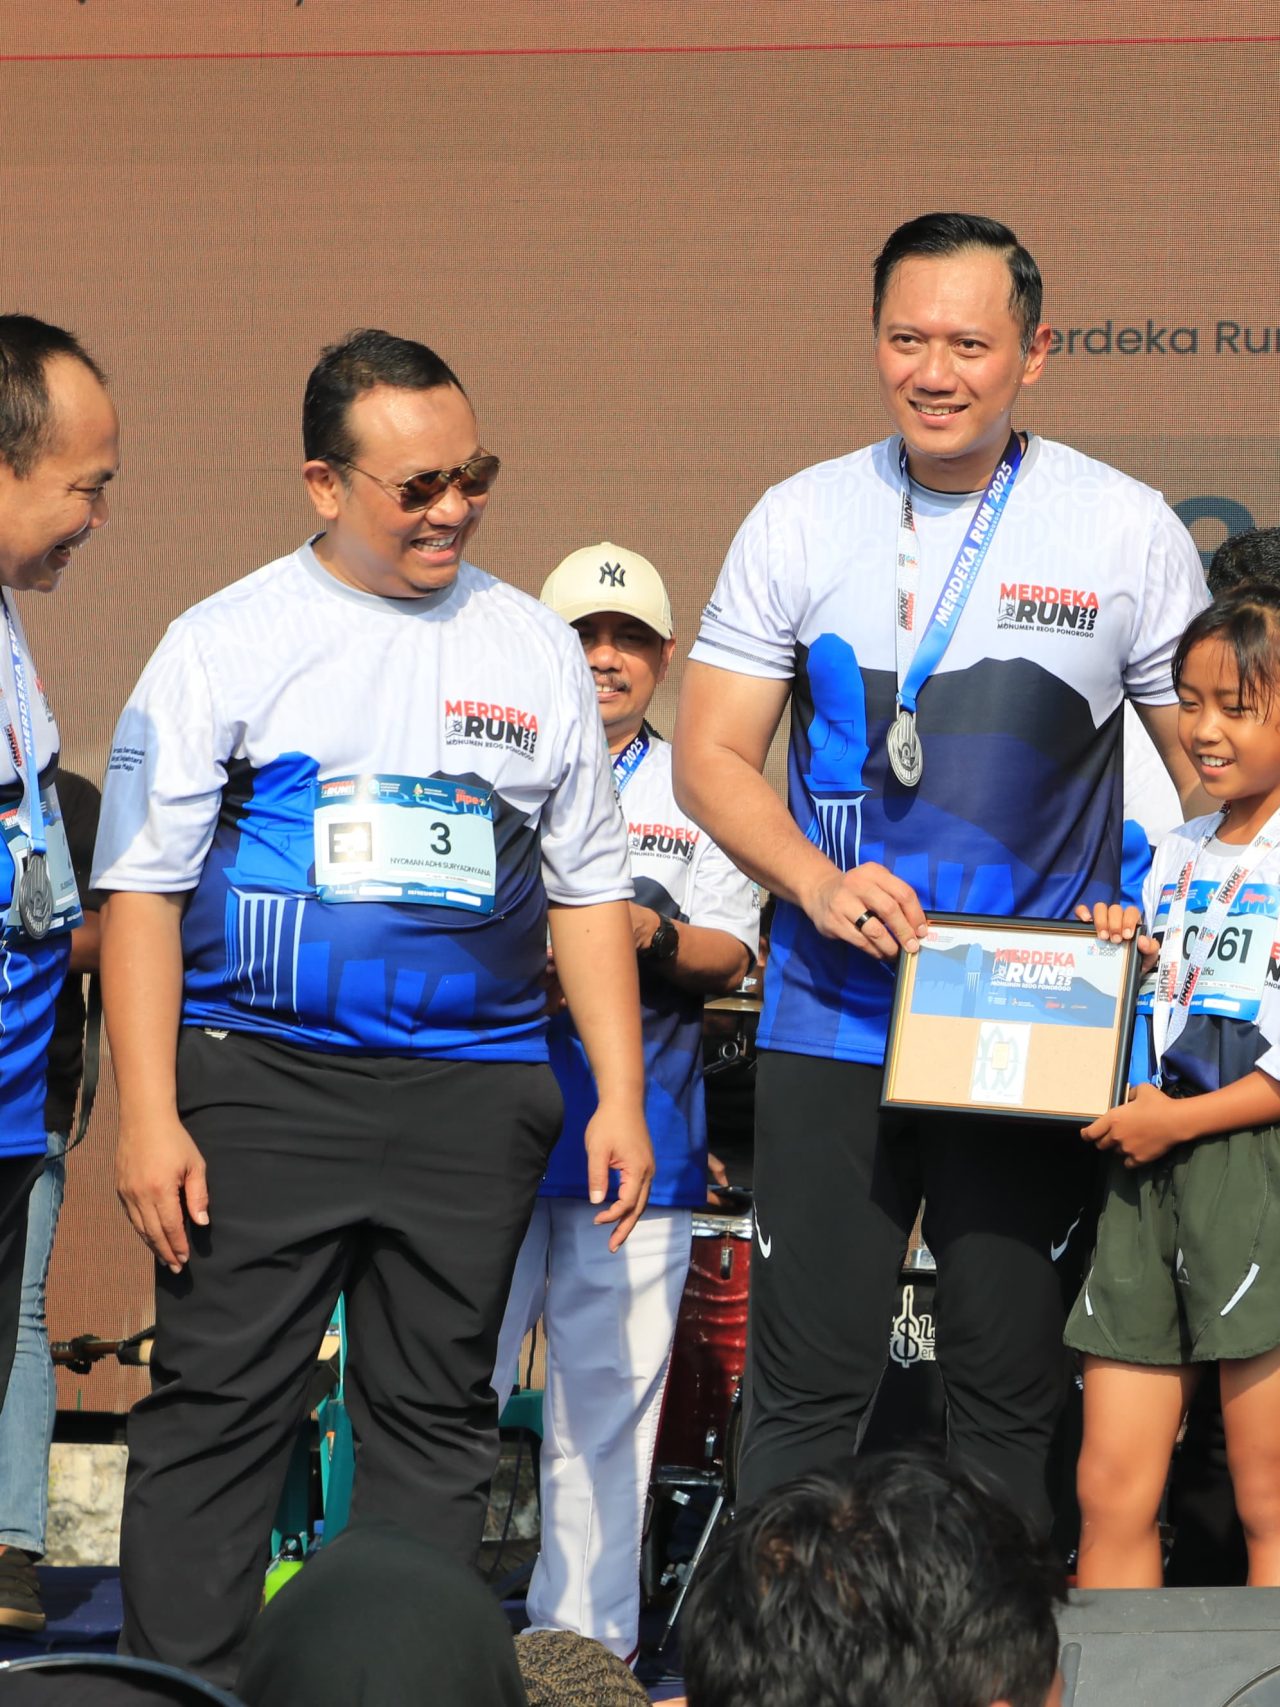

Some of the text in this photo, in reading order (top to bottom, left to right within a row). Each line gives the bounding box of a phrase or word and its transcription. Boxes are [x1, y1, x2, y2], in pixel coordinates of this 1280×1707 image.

[1048, 319, 1198, 355] erdeka
[935, 461, 1013, 629] MERDEKA RUN 2025
[599, 561, 626, 587] NY
[1000, 582, 1099, 609] MERDEKA
[1015, 600, 1080, 628] RUN
[1078, 618, 1094, 630] 25
[1079, 607, 1098, 619] 20
[997, 623, 1034, 631] MONUMEN
[1056, 628, 1095, 638] PONOROGO
[14, 664, 32, 756] MERDEKA
[445, 700, 538, 734] MERDEKA
[446, 739, 483, 747] MONUMEN
[464, 716, 524, 747] RUN
[522, 740, 535, 754] 25
[622, 737, 644, 767] 2025
[430, 821, 452, 855] 3
[640, 834, 690, 857] RUN
[390, 857, 424, 866] NYOMAN
[995, 948, 1076, 967] MERDEKA
[1006, 962, 1060, 986] RUN
[1057, 976, 1072, 986] 25
